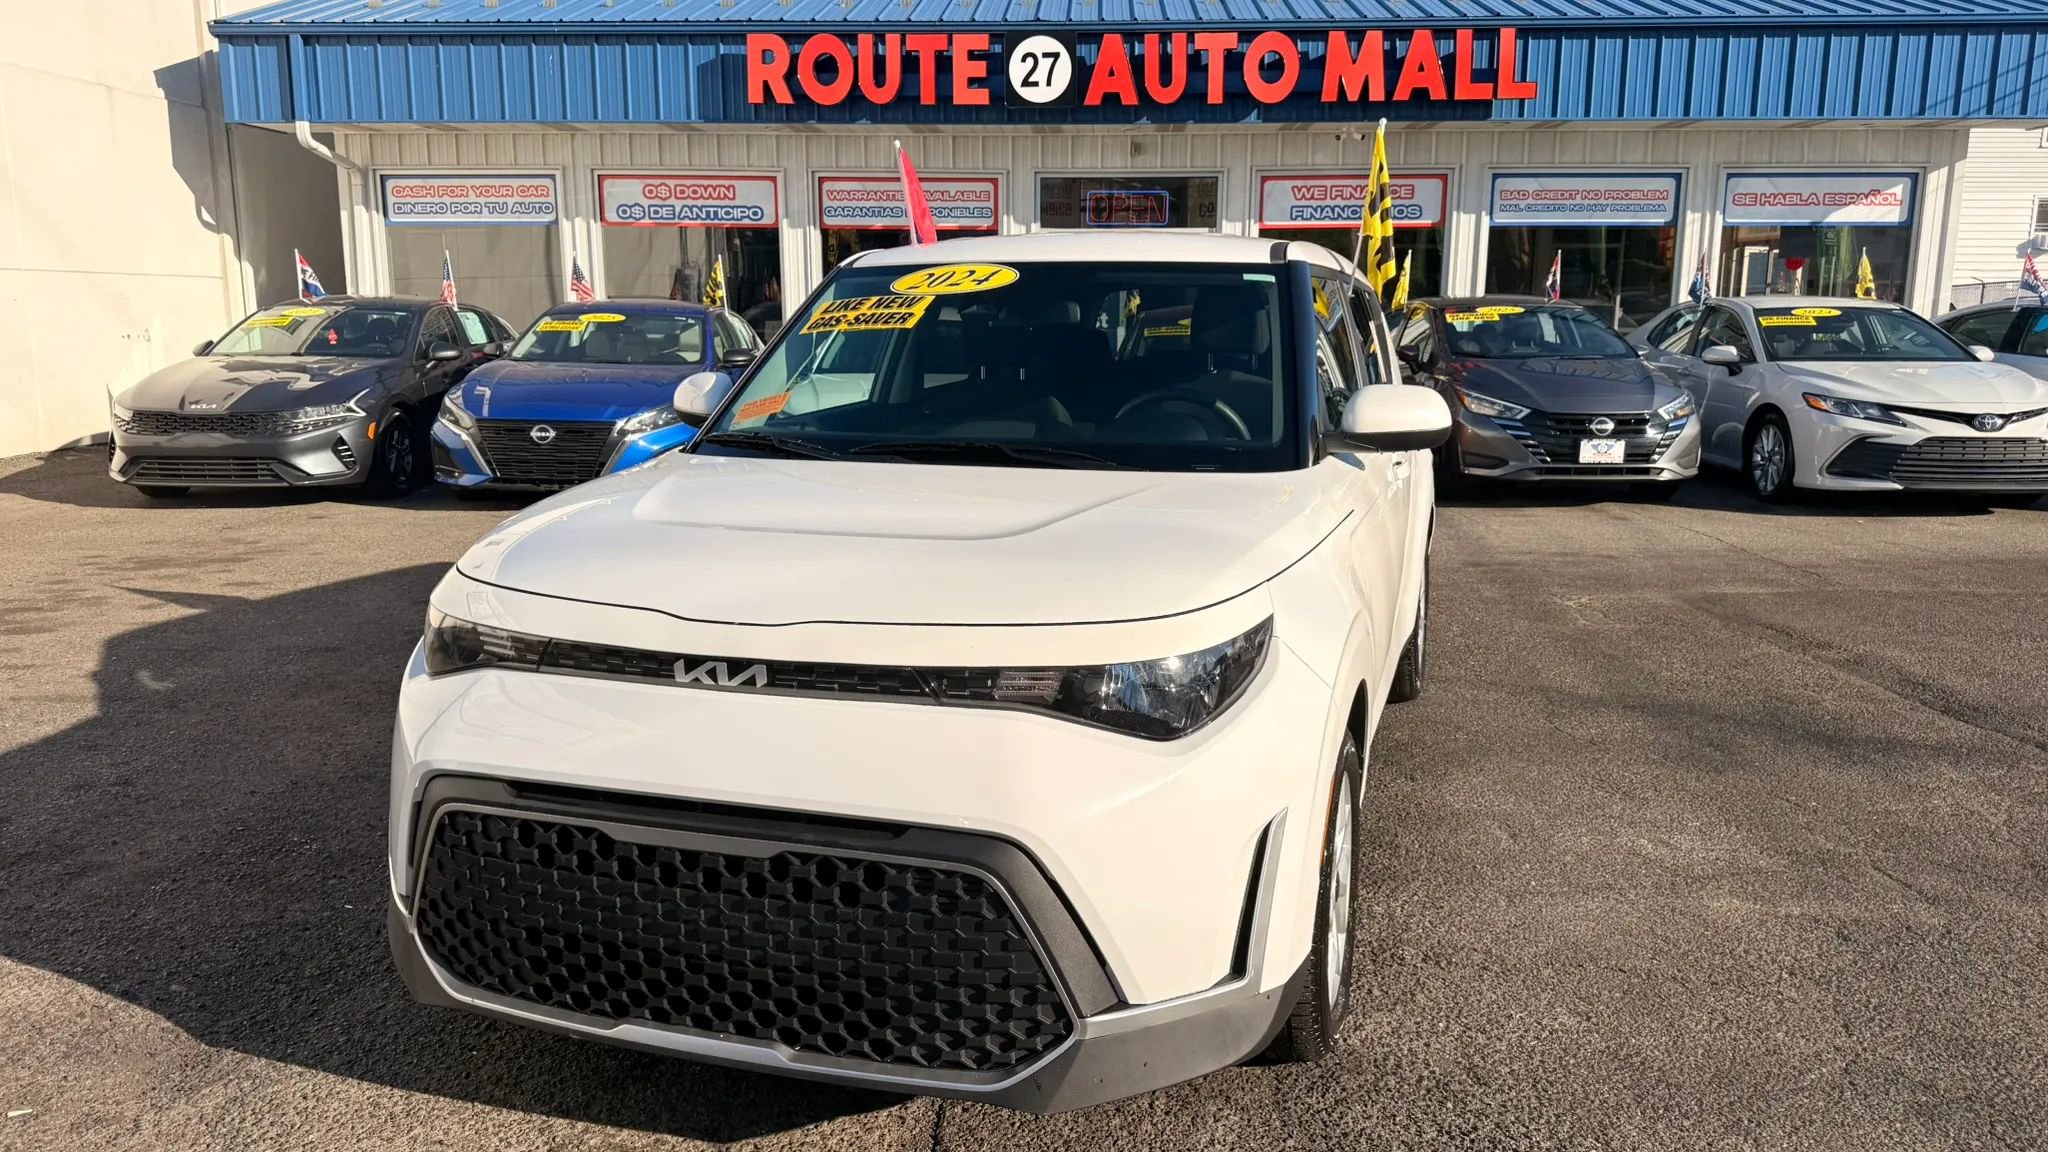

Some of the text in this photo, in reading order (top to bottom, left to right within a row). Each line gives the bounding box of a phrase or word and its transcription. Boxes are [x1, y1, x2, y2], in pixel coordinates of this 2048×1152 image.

[746, 28, 1538, 106] ROUTE 27 AUTO MALL
[392, 185, 549, 198] CASH FOR YOUR CAR
[675, 184, 736, 200] DOWN
[826, 189, 905, 203] WARRANTIE
[1292, 184, 1415, 201] WE FINCE
[1500, 189, 1668, 201] BAD CREDIT NO PROBLEM
[1733, 189, 1903, 206] SE HABLA ESPAÑOL
[393, 202, 554, 215] DINERO POR TU AUTO
[648, 205, 676, 219] DE
[678, 205, 764, 221] ANTICIPO
[824, 206, 993, 219] GARANTIAS PONIBLES
[1091, 193, 1166, 223] OPEN
[1290, 204, 1423, 221] FINANCOS
[1499, 203, 1667, 213] MAL CREDITO NO HAY PROBLEMA
[906, 268, 1002, 291] 2024
[823, 296, 926, 315] LIKE NEW
[673, 658, 768, 688] KIA
